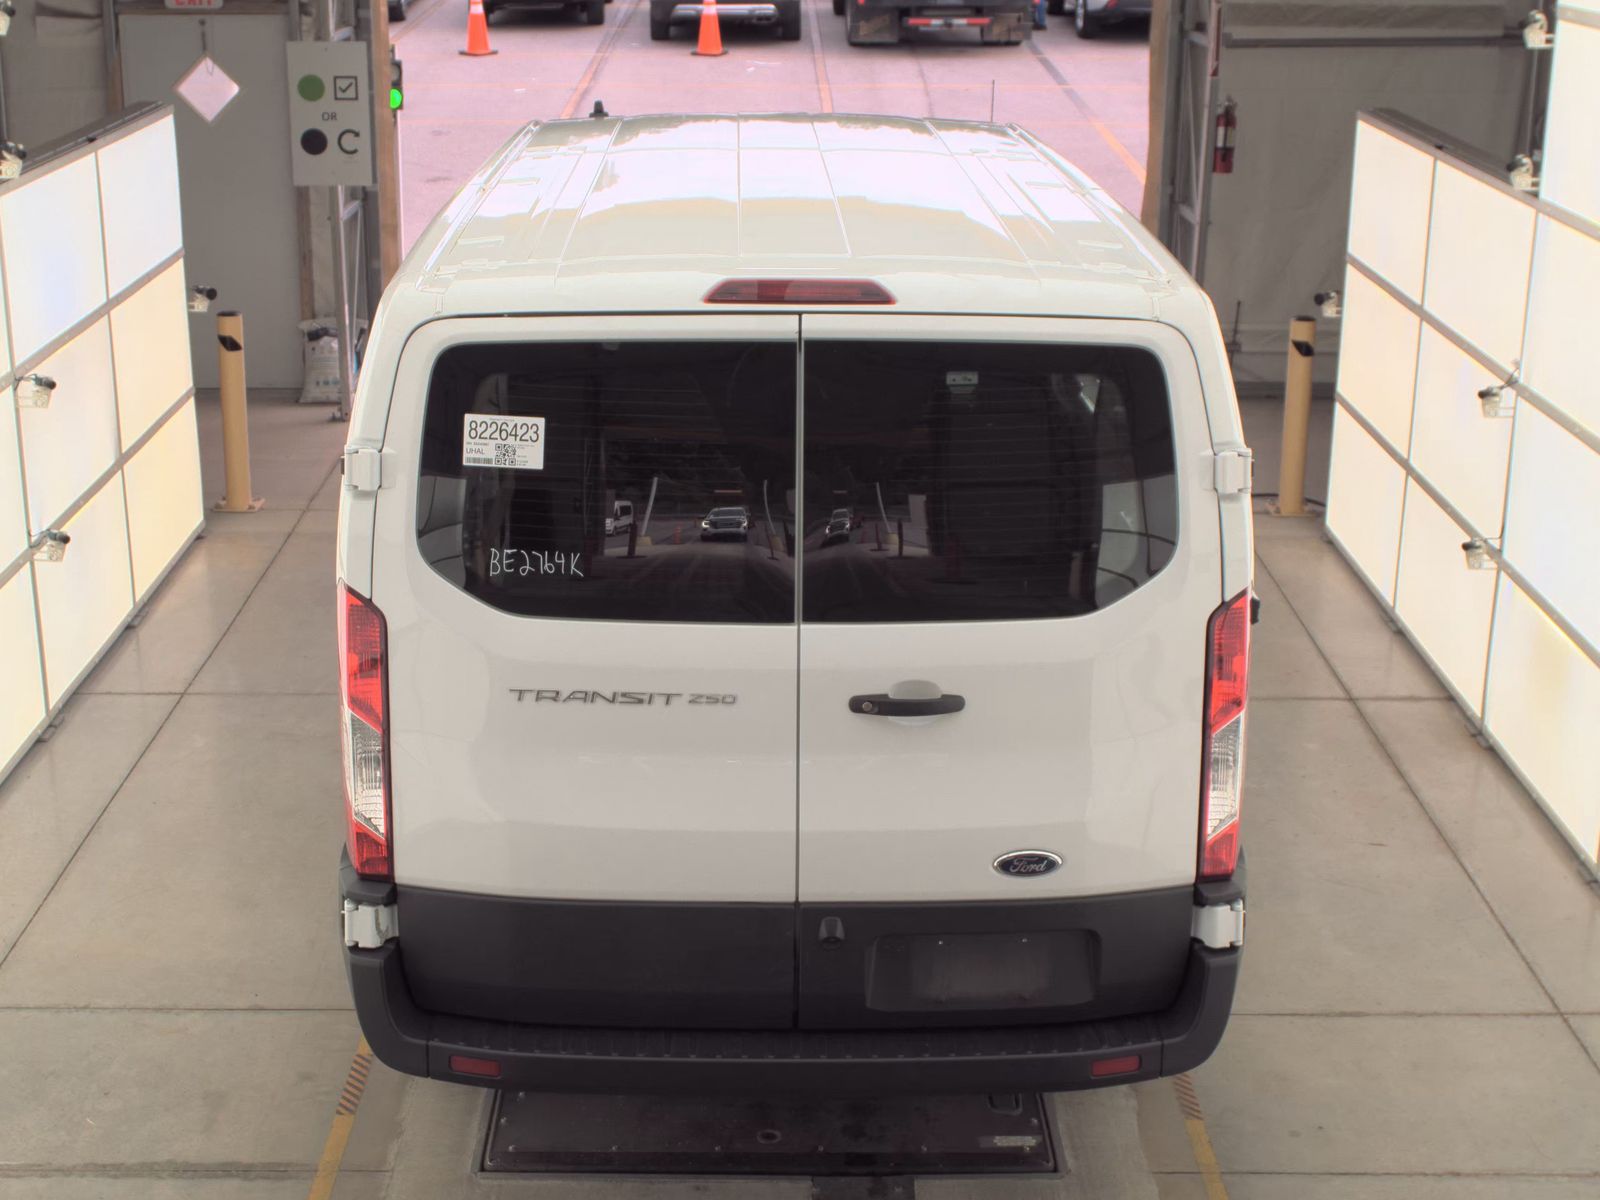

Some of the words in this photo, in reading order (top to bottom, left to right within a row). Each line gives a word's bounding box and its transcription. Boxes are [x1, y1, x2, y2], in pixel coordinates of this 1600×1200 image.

[321, 111, 338, 121] OR
[468, 420, 540, 443] 8226423
[465, 447, 486, 455] UHAL
[489, 547, 584, 577] BE2764K
[509, 688, 683, 706] TRANSIT
[688, 693, 738, 706] 250
[1009, 856, 1048, 873] Ford
